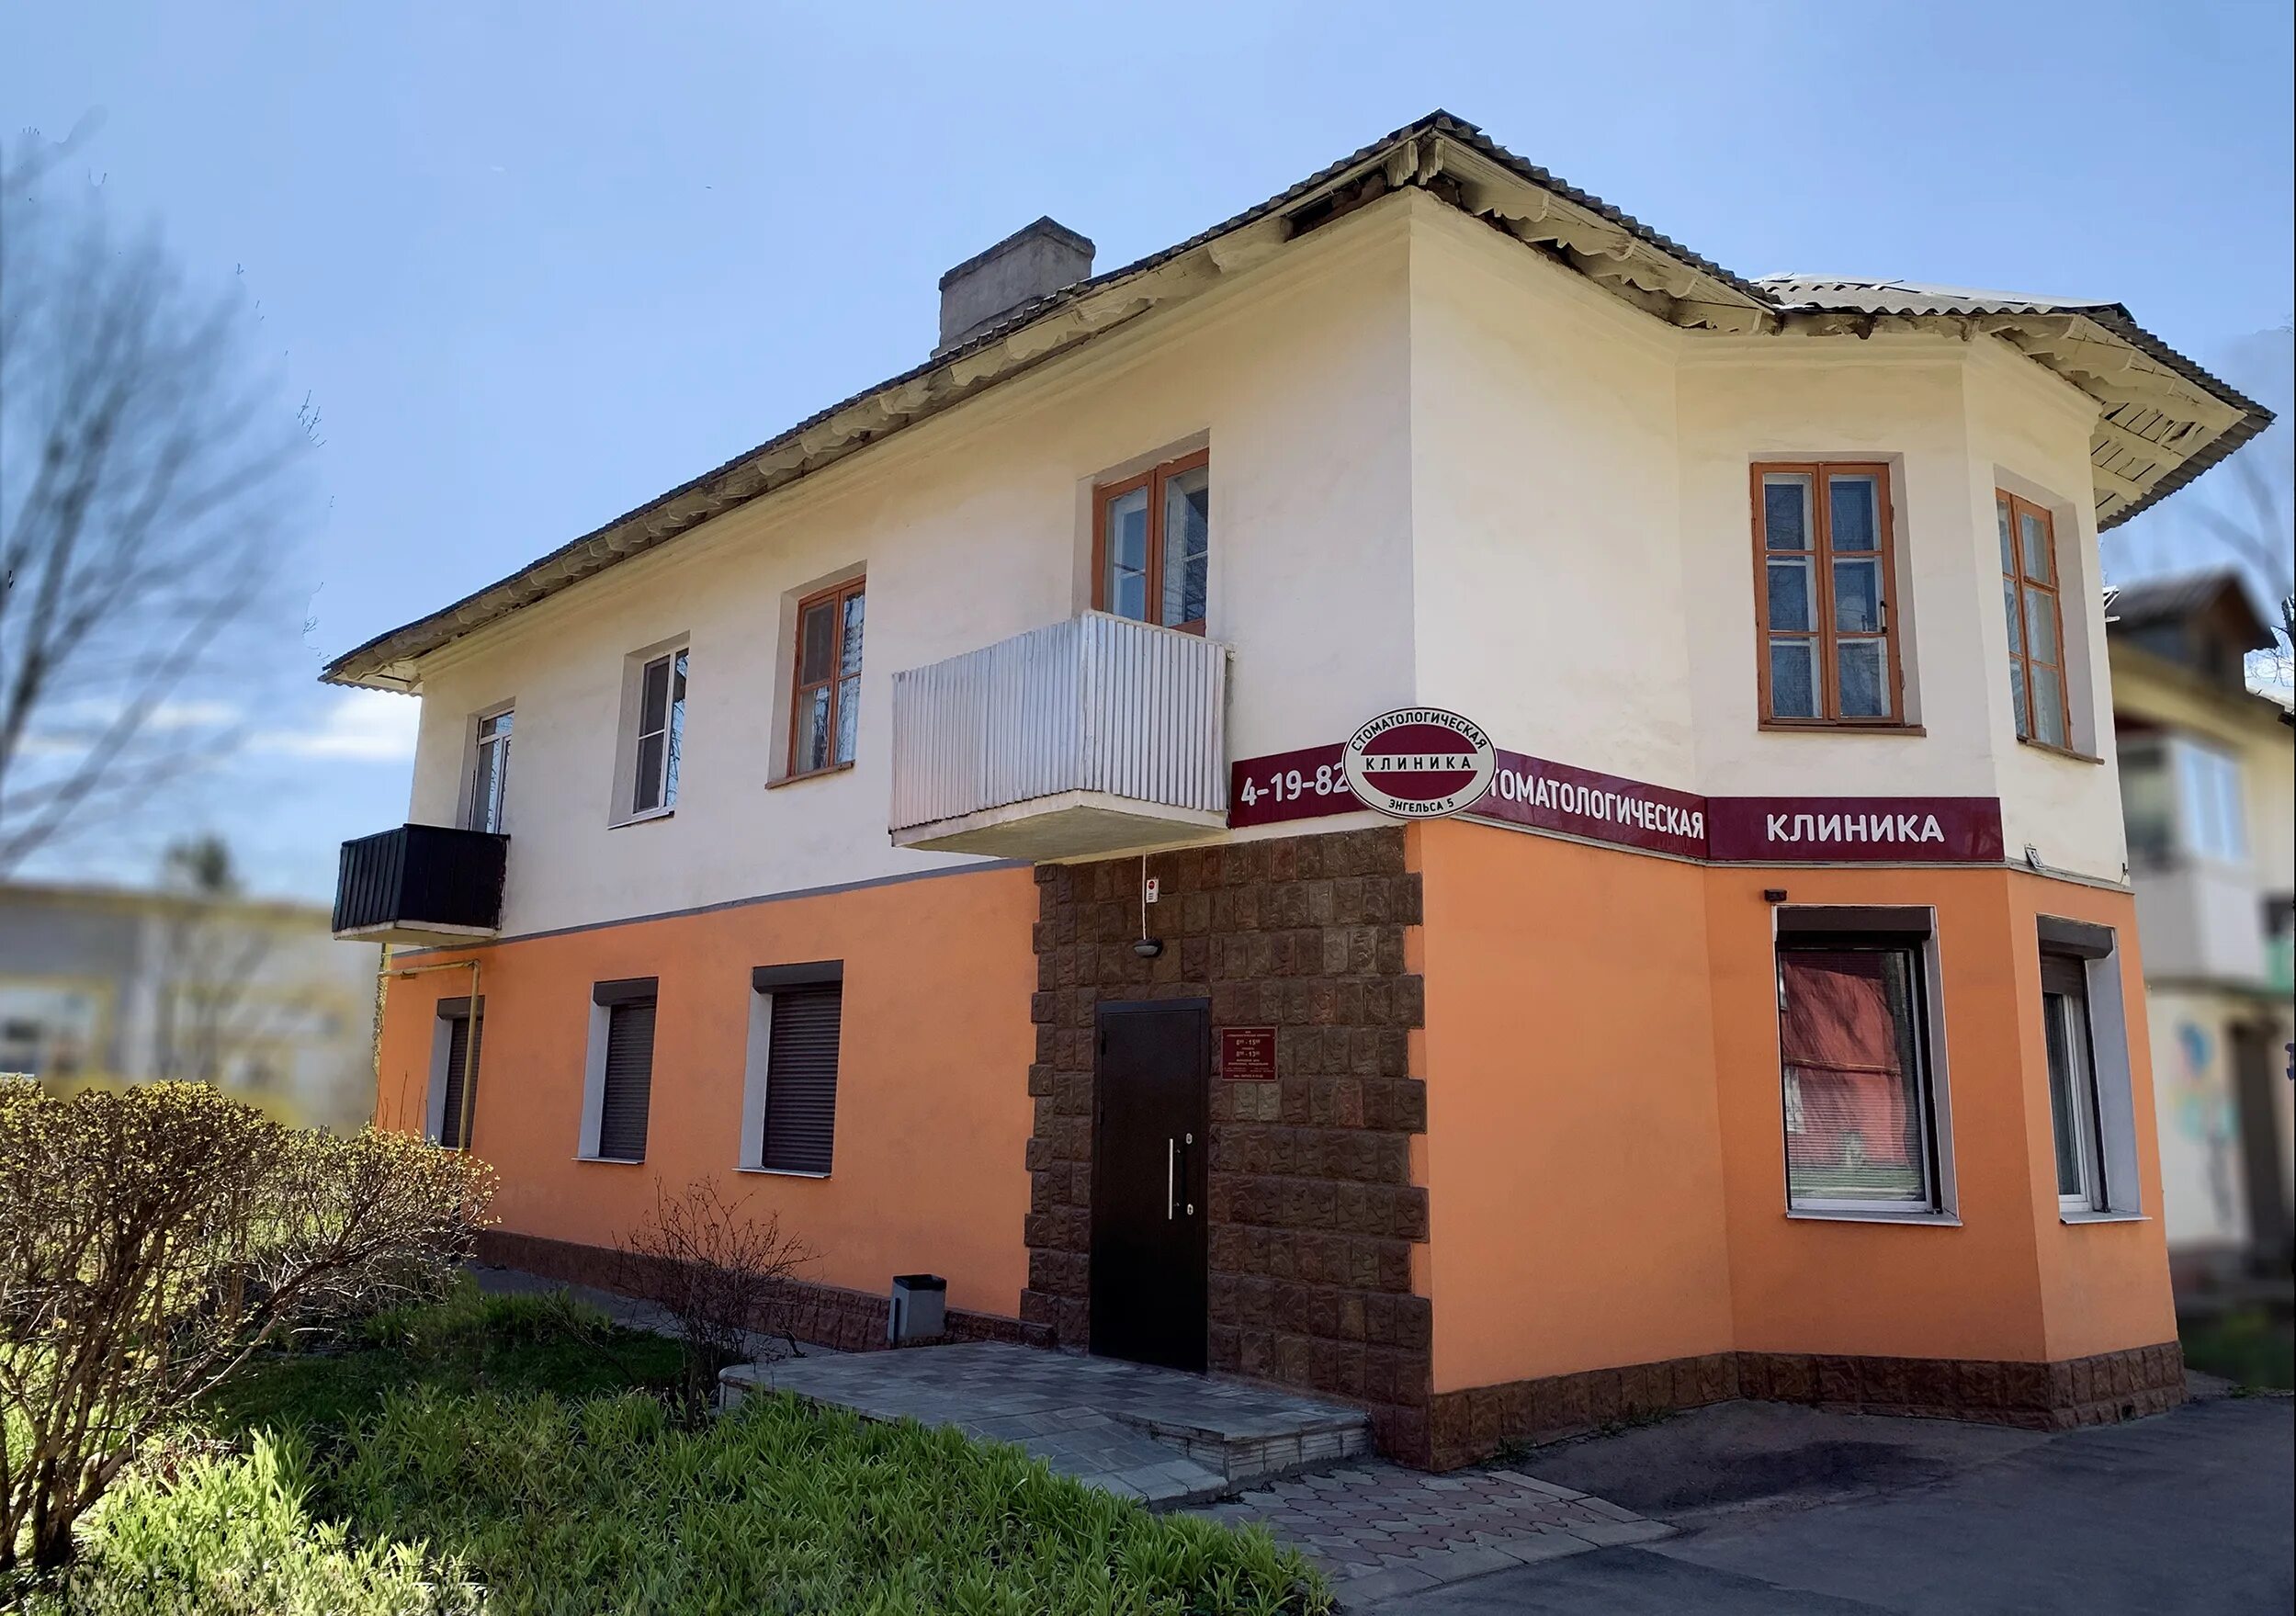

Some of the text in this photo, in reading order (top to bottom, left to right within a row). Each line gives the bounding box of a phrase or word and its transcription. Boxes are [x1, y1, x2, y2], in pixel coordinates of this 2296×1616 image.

[1351, 711, 1487, 751] СТОМАТОЛОГИЧЕСКАЯ
[1365, 756, 1471, 771] КЛИНИКА
[1240, 763, 1349, 807] 4-19-82
[1388, 797, 1454, 813] ЭНГЕЛЬСА 5
[1488, 768, 1945, 843] ТОМАТОЛОГИЧЕСКАЯ КЛИНИКА
